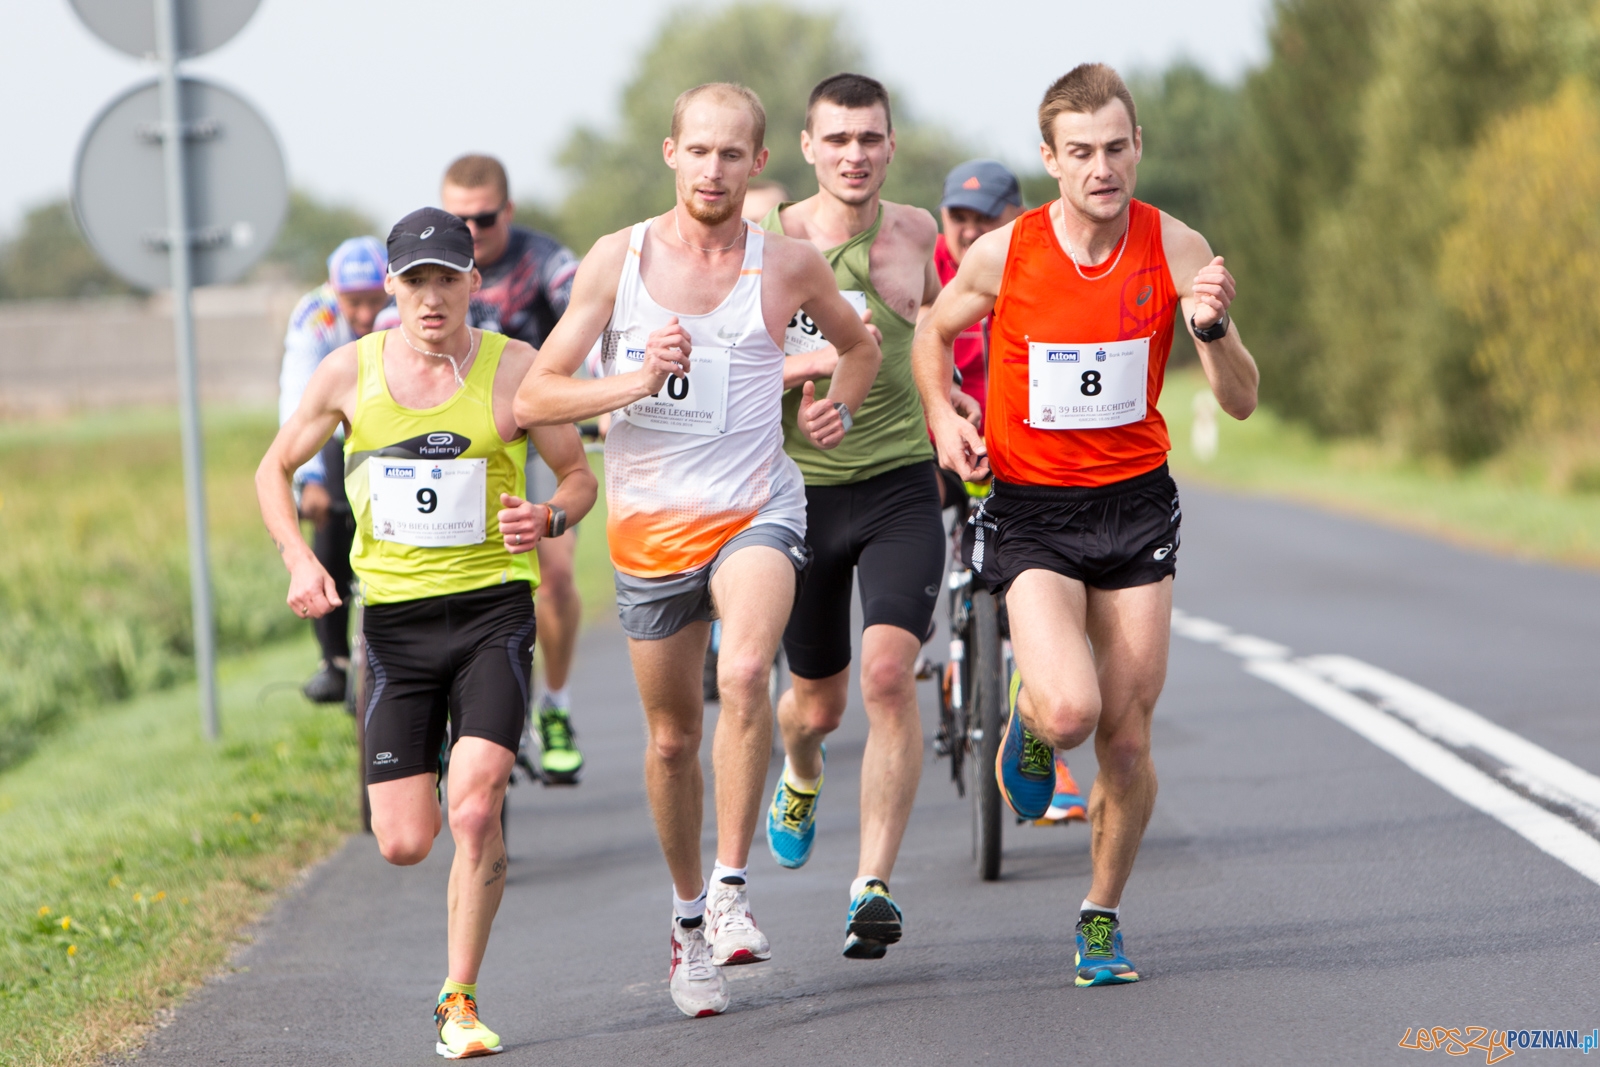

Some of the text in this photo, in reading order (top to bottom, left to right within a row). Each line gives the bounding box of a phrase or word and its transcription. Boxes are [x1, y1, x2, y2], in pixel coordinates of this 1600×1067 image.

[1080, 370, 1102, 396] 8
[633, 404, 643, 412] 39
[645, 406, 666, 415] BIEG
[668, 409, 714, 419] LECHITÓW
[1072, 405, 1094, 413] BIEG
[1096, 399, 1137, 412] LECHITÓW
[420, 447, 460, 455] Kalenji
[416, 488, 438, 514] 9
[397, 521, 407, 529] 39
[409, 522, 429, 530] BIEG
[432, 520, 474, 530] LECHITÓW
